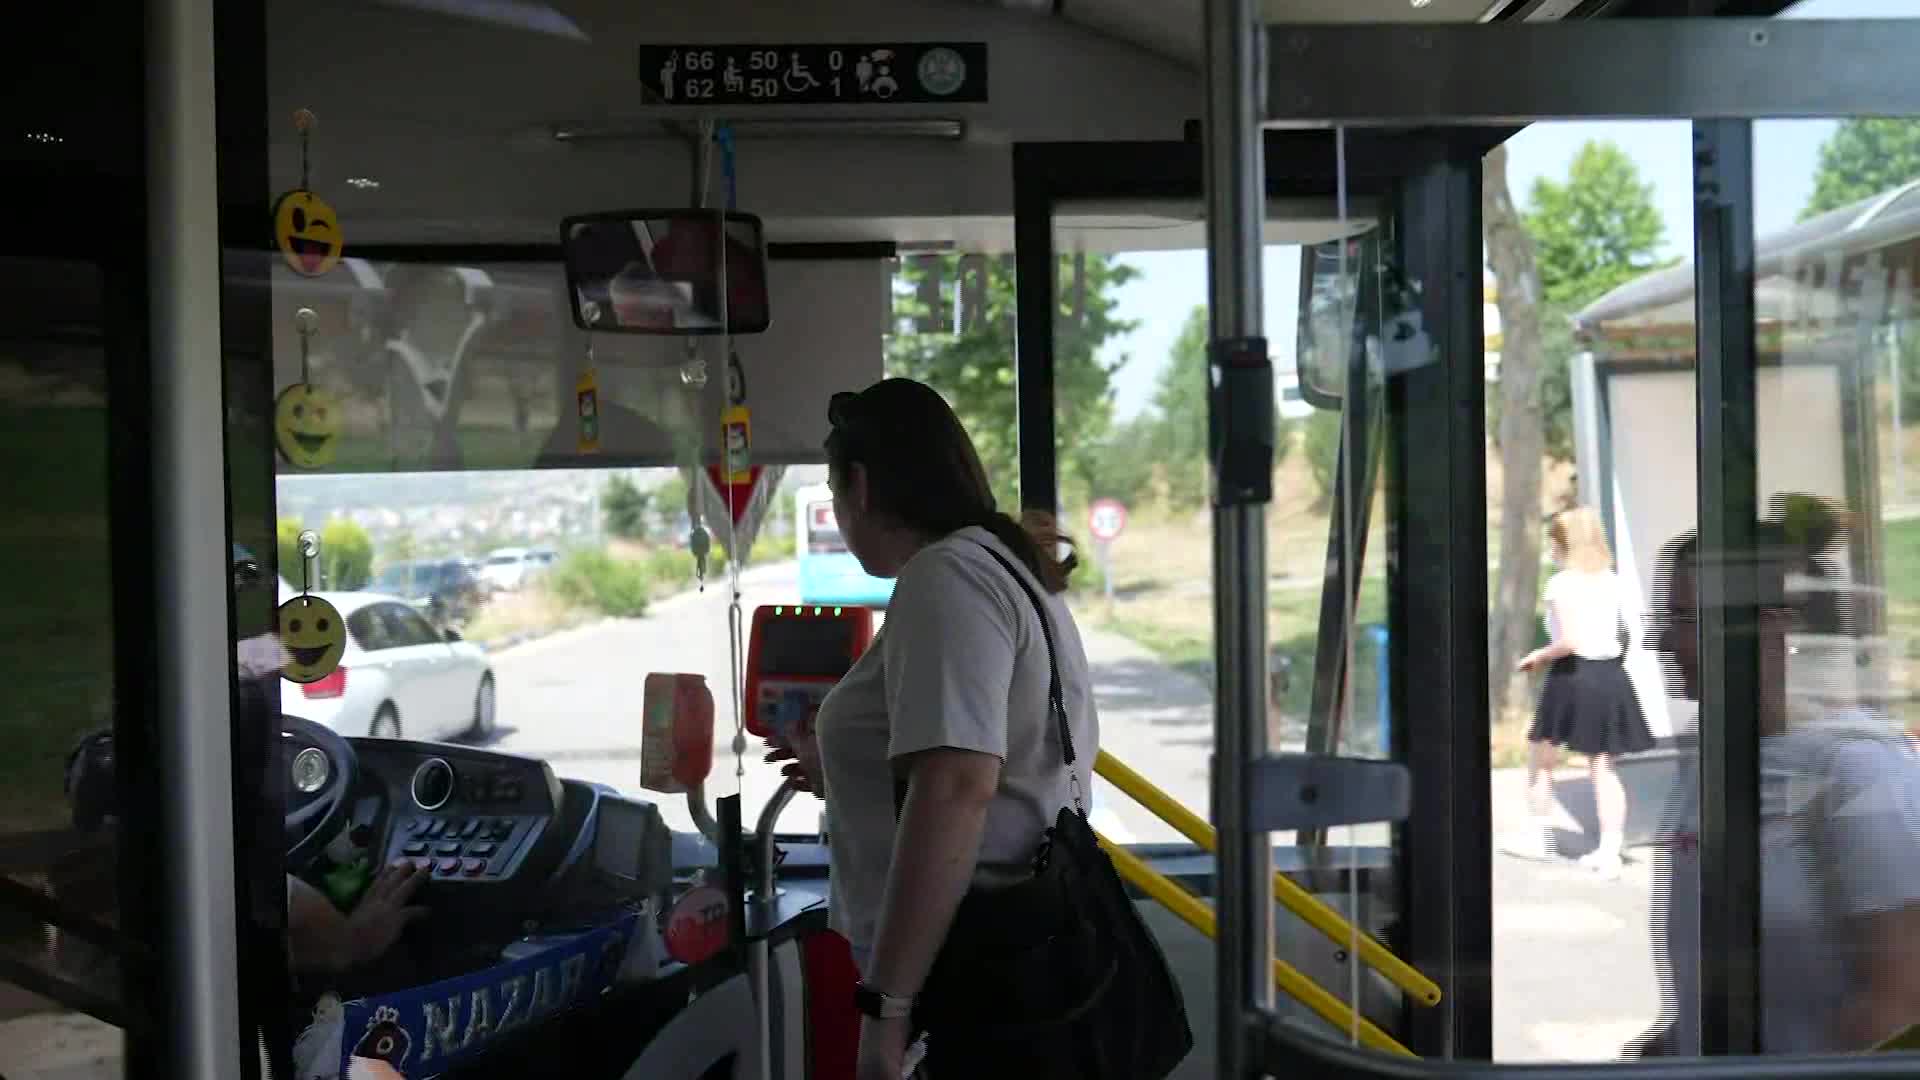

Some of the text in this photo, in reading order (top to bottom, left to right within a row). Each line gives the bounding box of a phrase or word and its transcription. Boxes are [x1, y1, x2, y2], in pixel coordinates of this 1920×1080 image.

[684, 50, 844, 71] 66 50 0
[684, 78, 842, 97] 62 50 1
